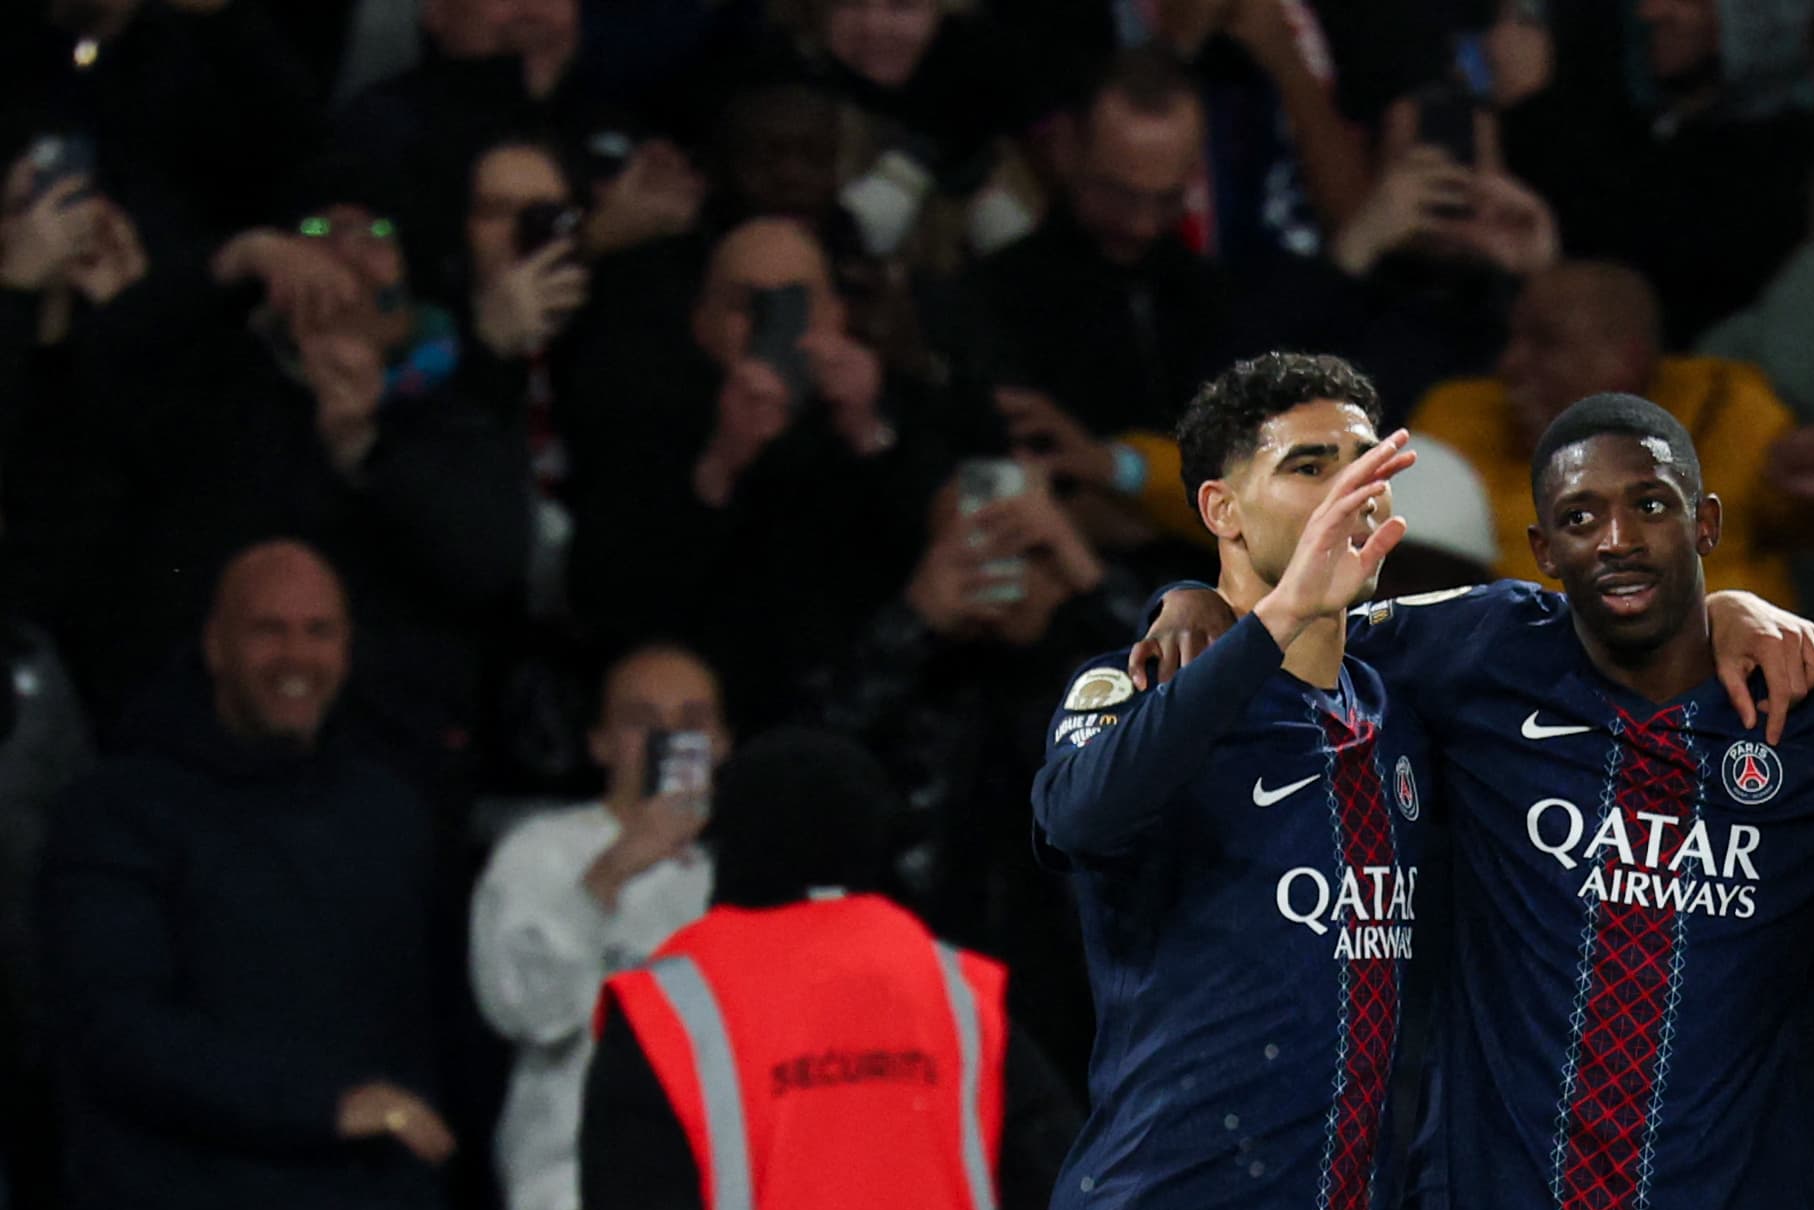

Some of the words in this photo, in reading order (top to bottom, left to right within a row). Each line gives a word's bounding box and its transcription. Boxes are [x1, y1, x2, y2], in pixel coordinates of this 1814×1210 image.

[1729, 742, 1768, 760] PARIS
[1526, 798, 1761, 880] QATAR
[1578, 866, 1757, 918] AIRWAYS
[1334, 925, 1413, 960] AIRWAY
